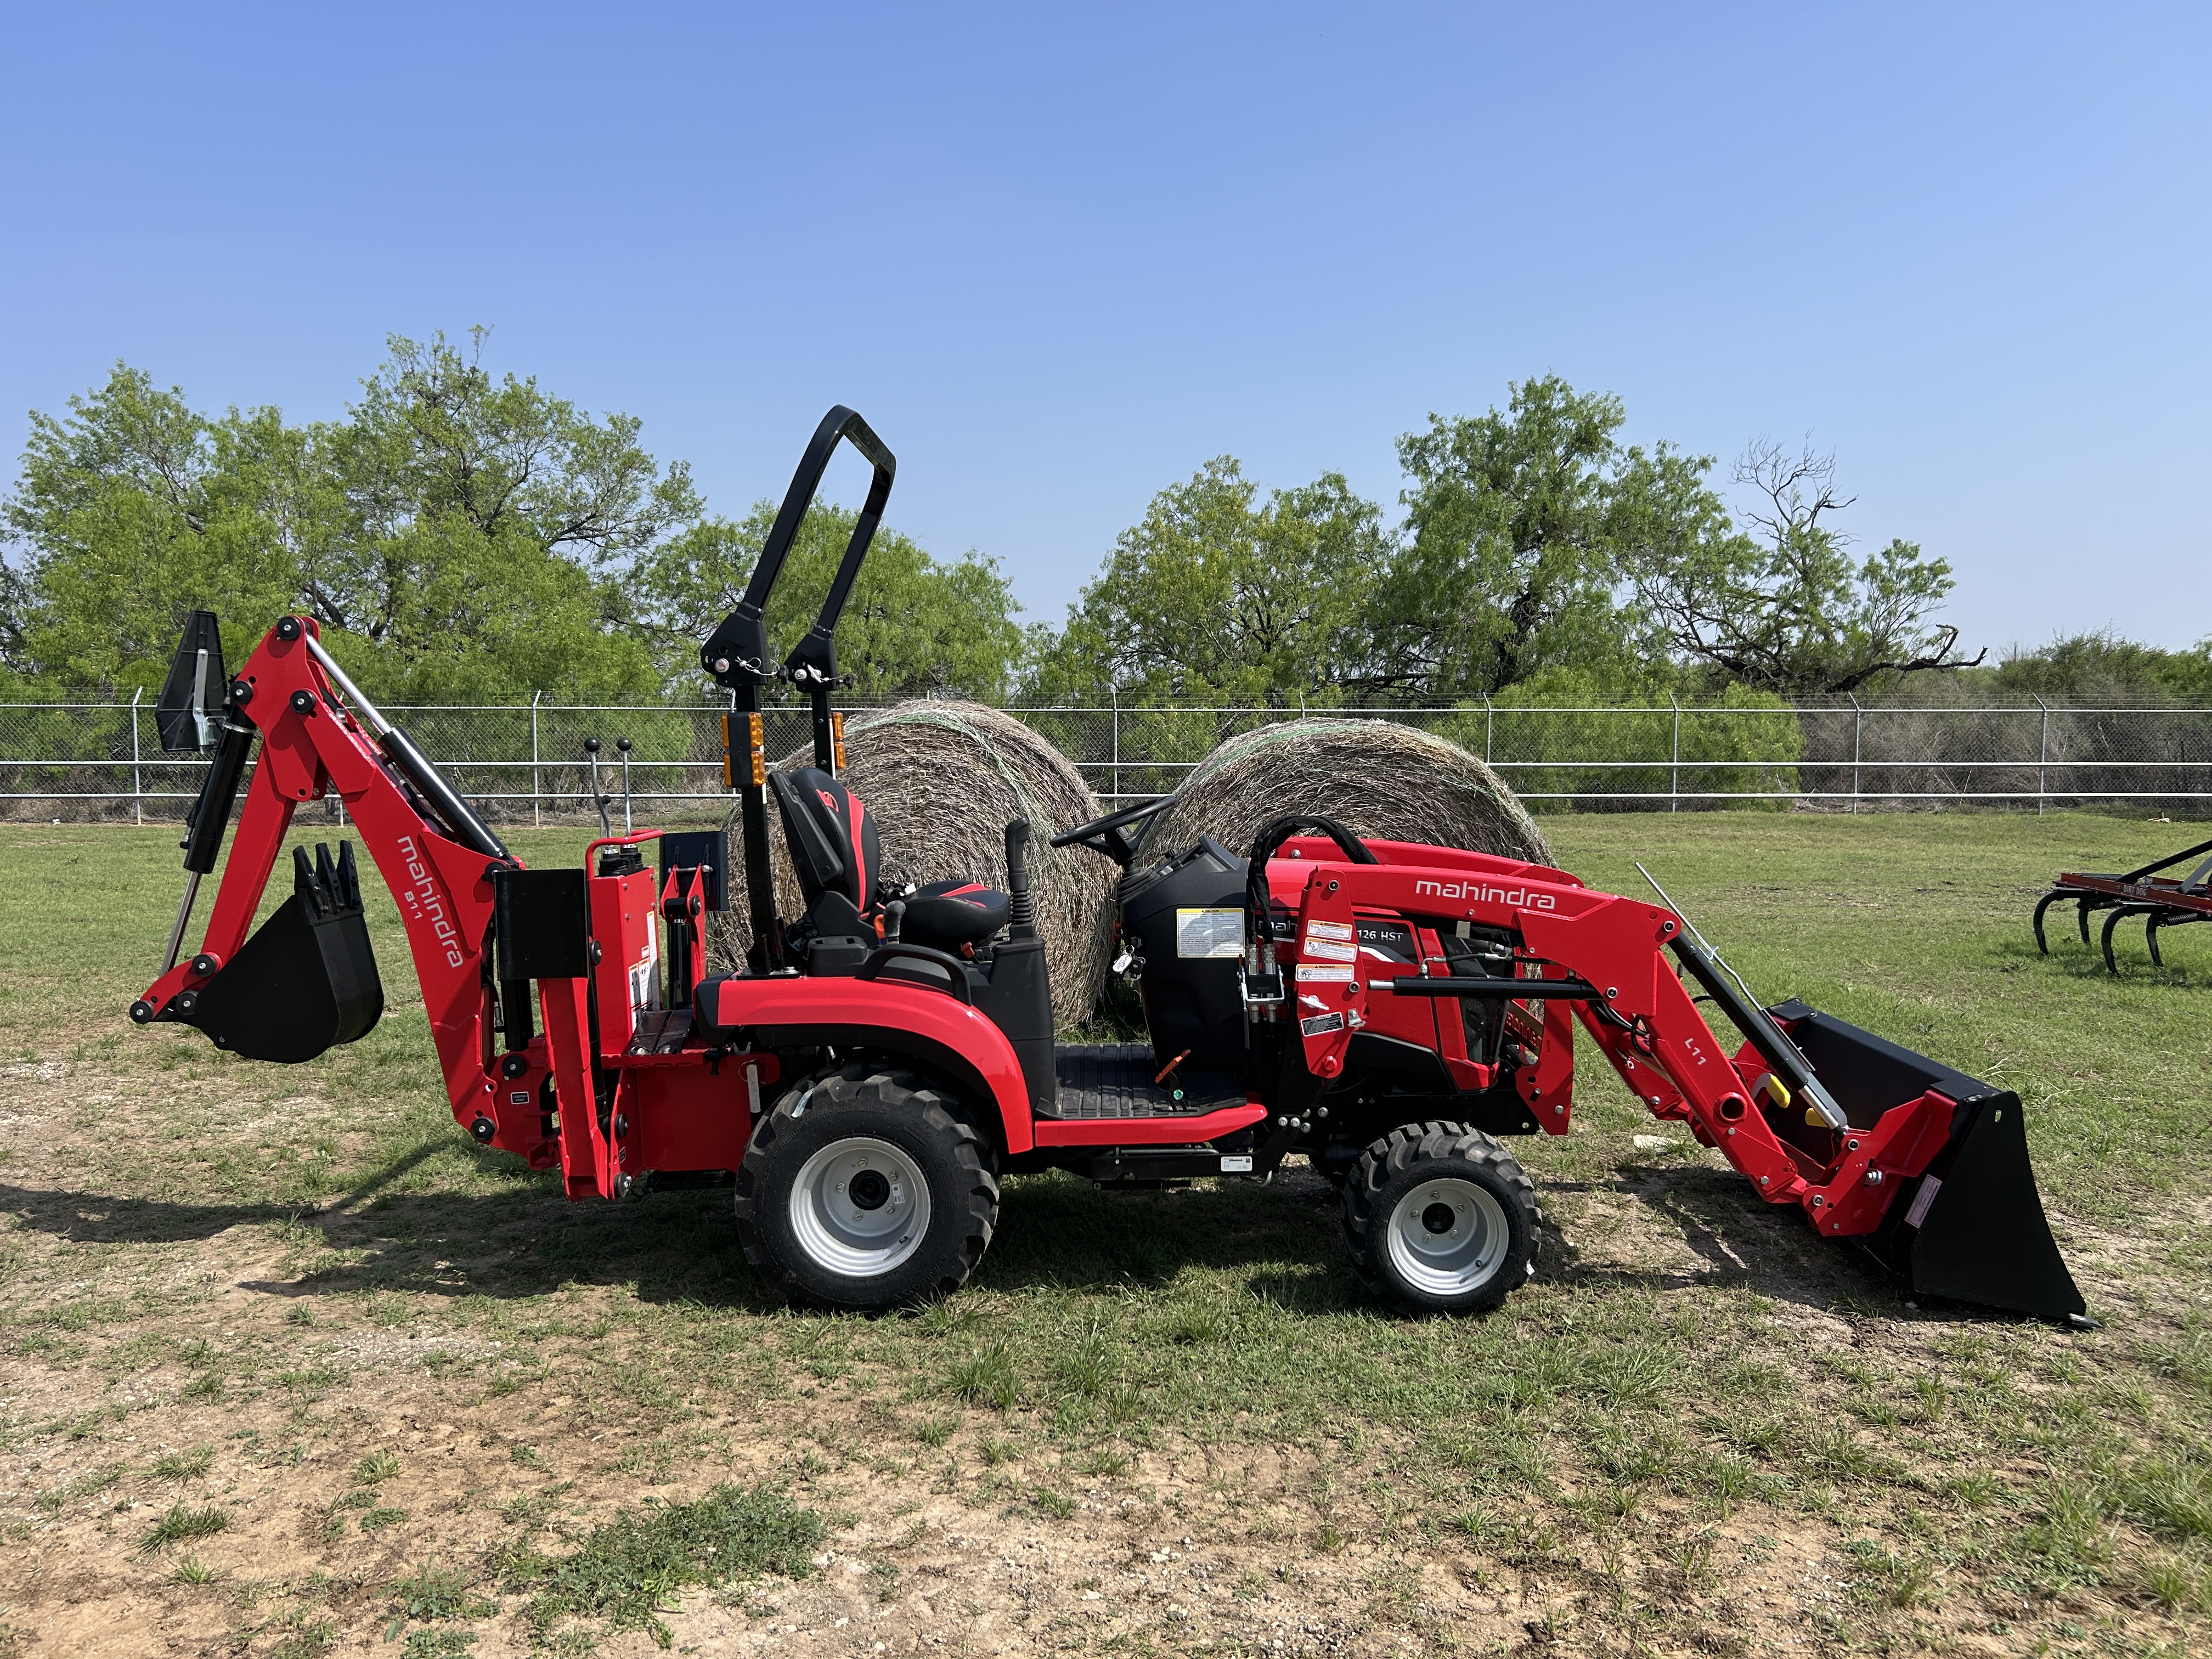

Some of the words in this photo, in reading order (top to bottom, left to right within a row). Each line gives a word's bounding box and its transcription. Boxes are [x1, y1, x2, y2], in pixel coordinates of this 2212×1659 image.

[398, 836, 464, 968] mahindra
[1415, 880, 1555, 910] mahindra
[2124, 884, 2135, 894] DIRT
[2136, 887, 2147, 896] DOG
[404, 890, 422, 919] B11
[1357, 929, 1377, 939] 126
[1380, 931, 1403, 942] HST
[1684, 1037, 1706, 1065] L11
